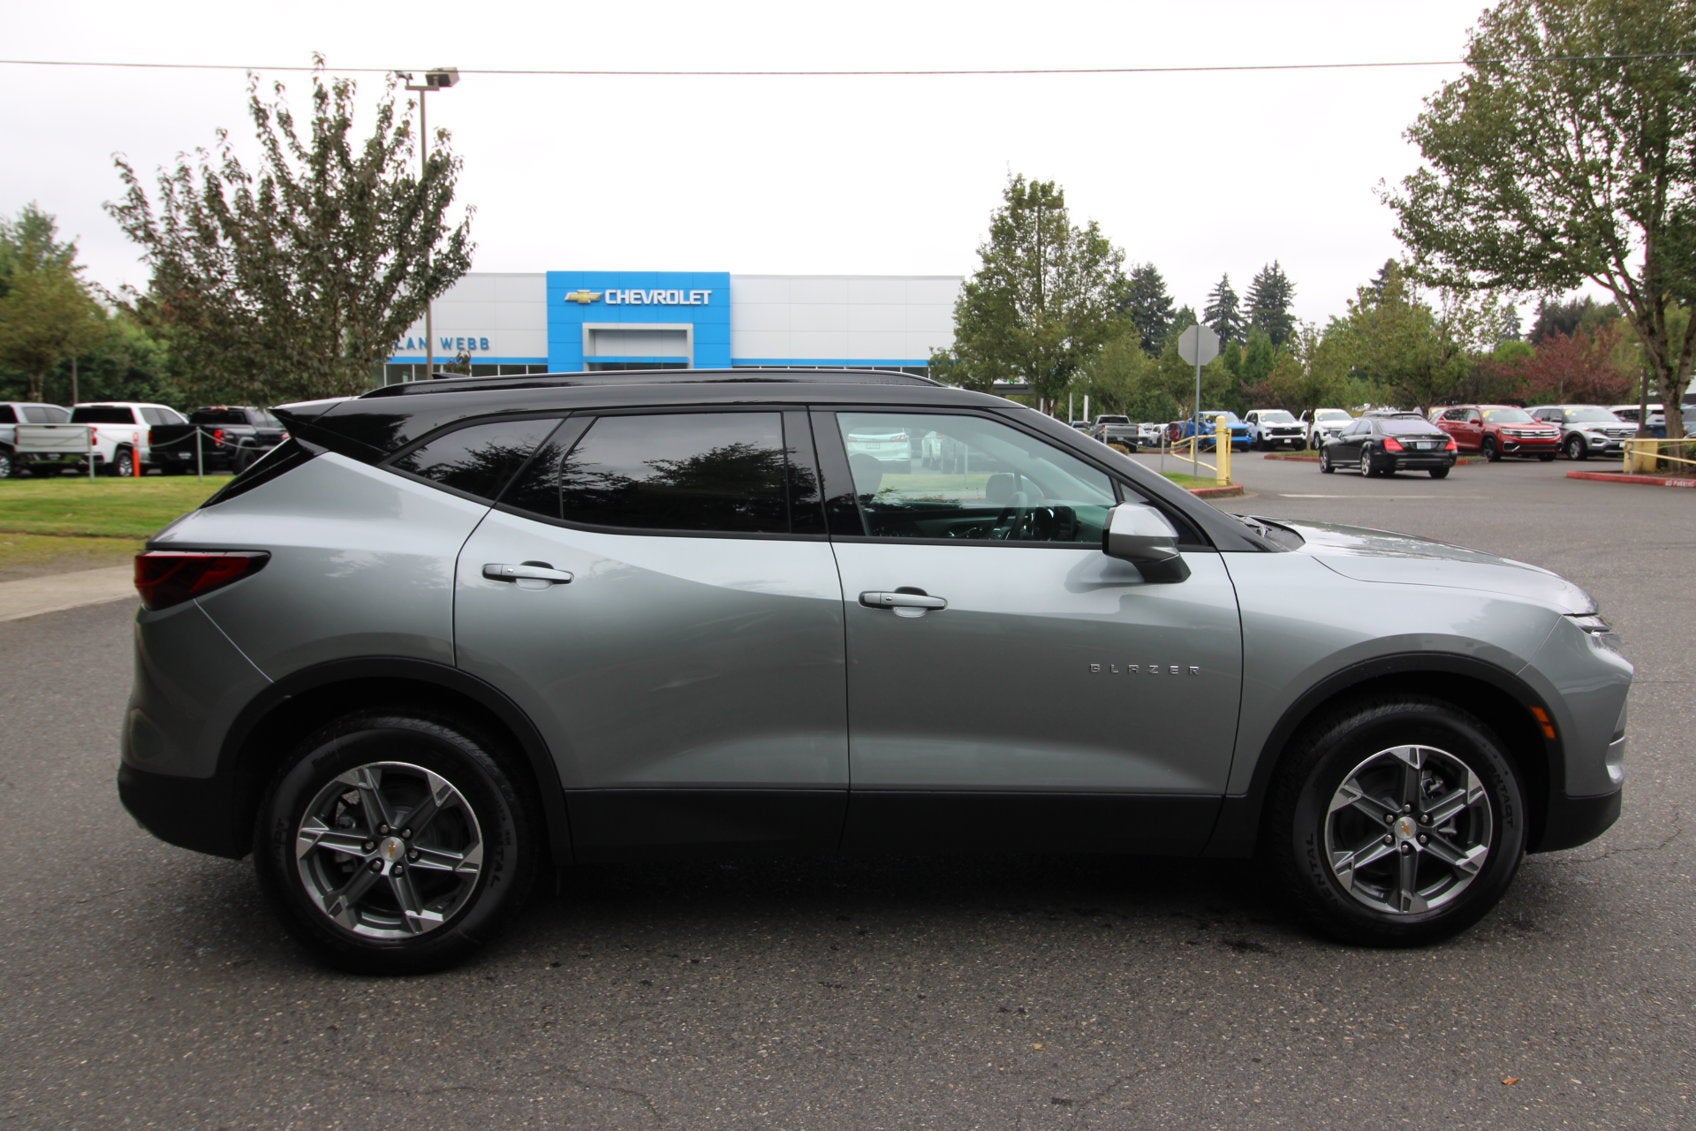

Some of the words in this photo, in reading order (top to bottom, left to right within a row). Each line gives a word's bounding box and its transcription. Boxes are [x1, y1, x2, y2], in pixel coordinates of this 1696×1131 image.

[605, 289, 712, 305] CHEVROLET
[440, 337, 489, 351] WEBB
[1090, 663, 1200, 676] BLAZER
